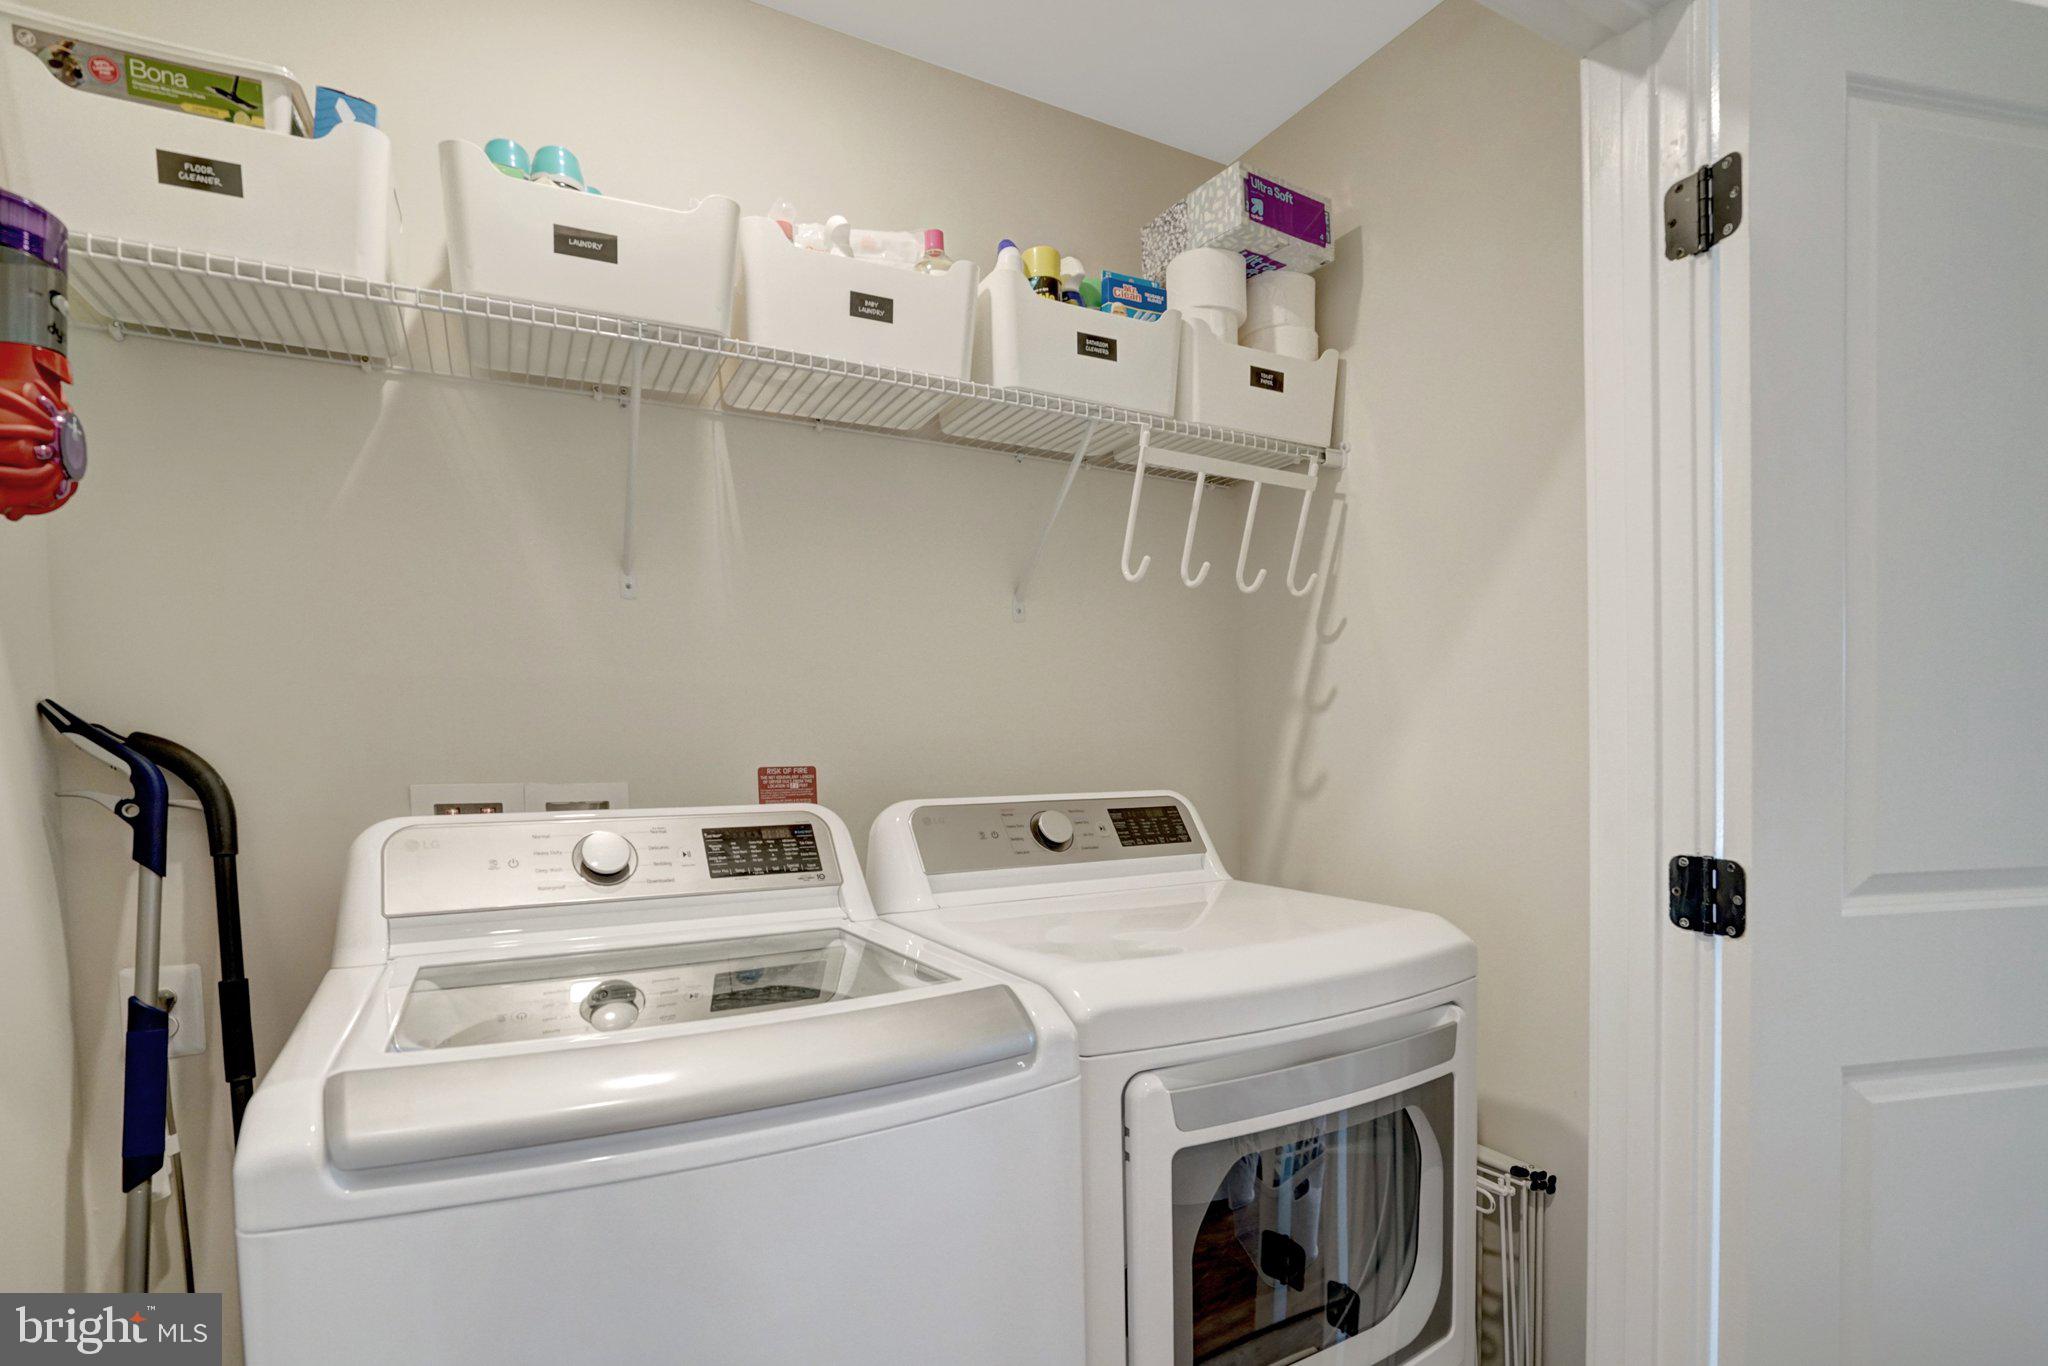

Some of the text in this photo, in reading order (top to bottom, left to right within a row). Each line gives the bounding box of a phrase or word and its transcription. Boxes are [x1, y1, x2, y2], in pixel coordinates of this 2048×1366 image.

[129, 58, 189, 89] Bona
[184, 162, 216, 176] FLOOR
[178, 171, 223, 187] CLEANER
[1250, 176, 1294, 205] Ultra Soft
[568, 238, 603, 251] LAUNDRY
[1112, 286, 1143, 303] Clean
[858, 306, 885, 317] LAUNDRY
[766, 767, 781, 775] RISK
[782, 767, 792, 775] OF
